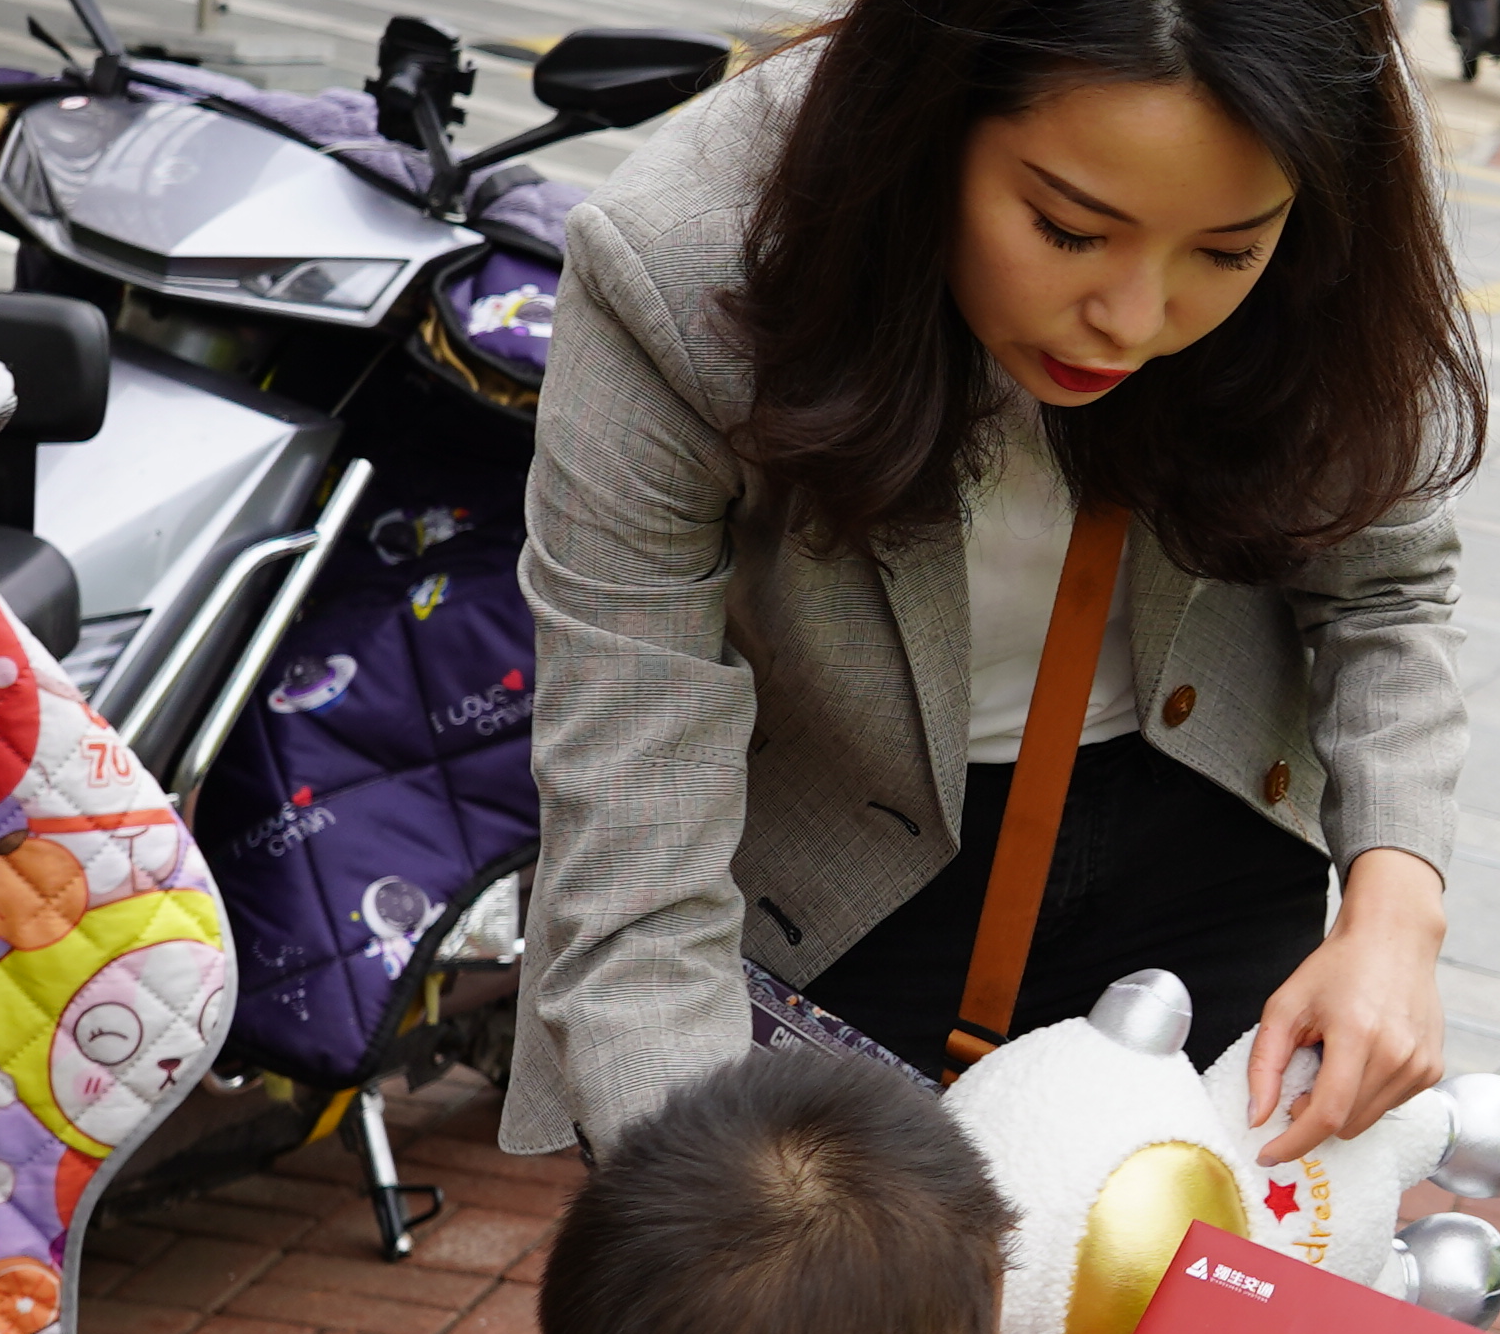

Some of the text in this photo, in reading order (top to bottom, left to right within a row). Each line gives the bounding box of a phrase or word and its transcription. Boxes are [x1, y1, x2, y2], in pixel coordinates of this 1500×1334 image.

[82, 738, 133, 784] 70
[1212, 1263, 1276, 1299] 强生交通
